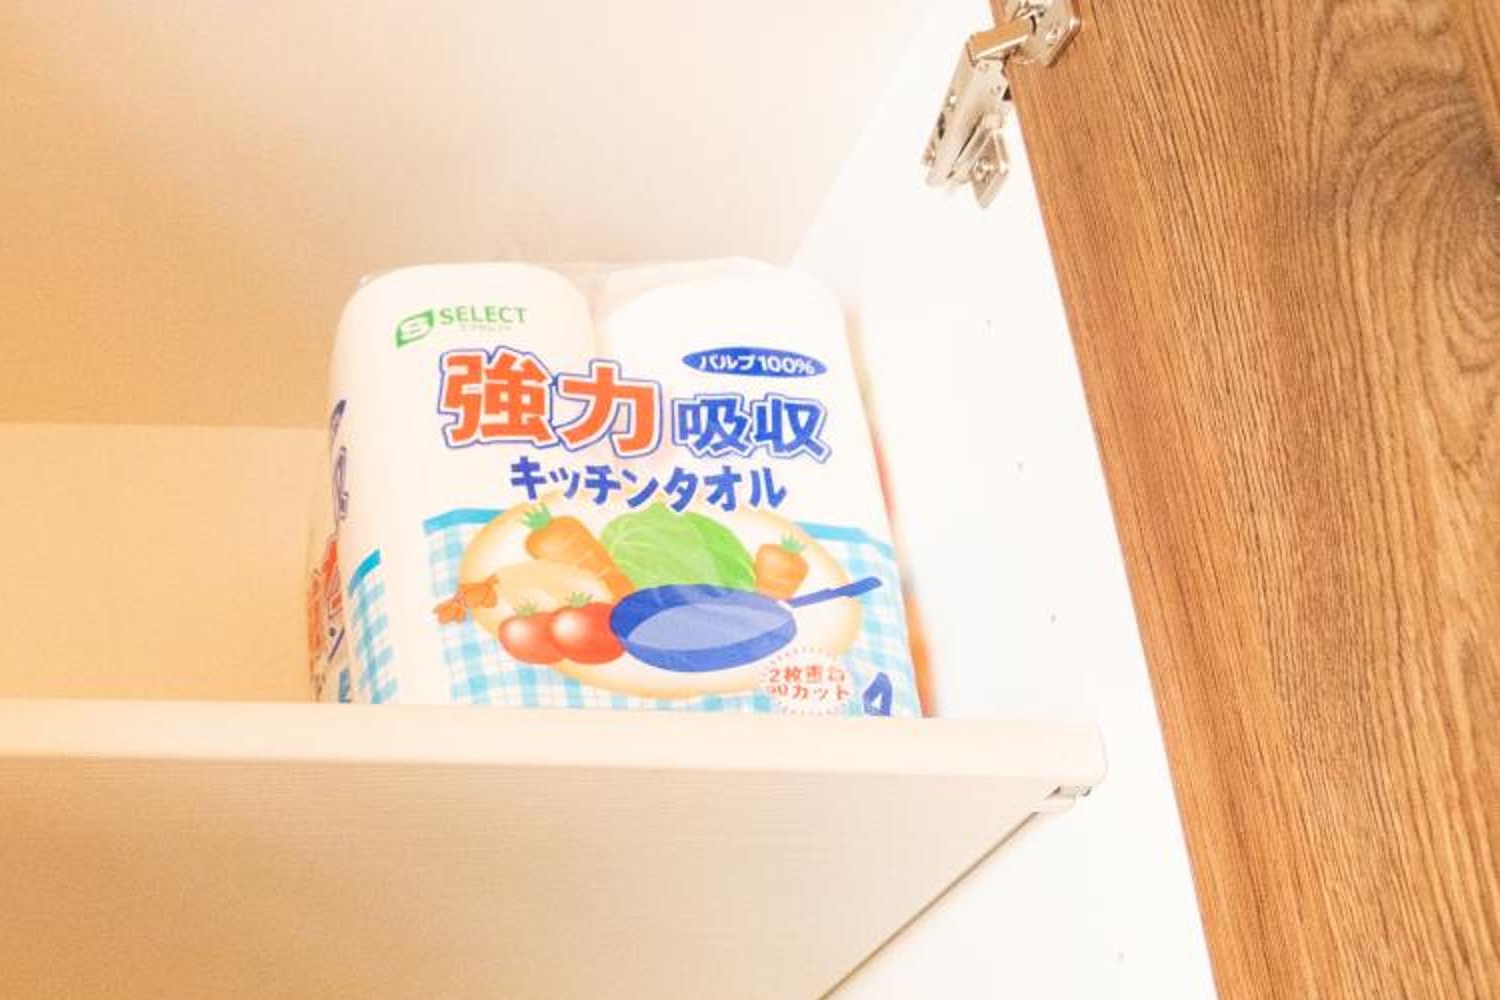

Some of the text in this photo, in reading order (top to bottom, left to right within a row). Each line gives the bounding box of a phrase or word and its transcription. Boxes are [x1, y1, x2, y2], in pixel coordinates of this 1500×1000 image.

[439, 304, 528, 324] SELECT
[438, 347, 832, 462] 強力 吸収
[510, 456, 787, 512] キッチンタオル
